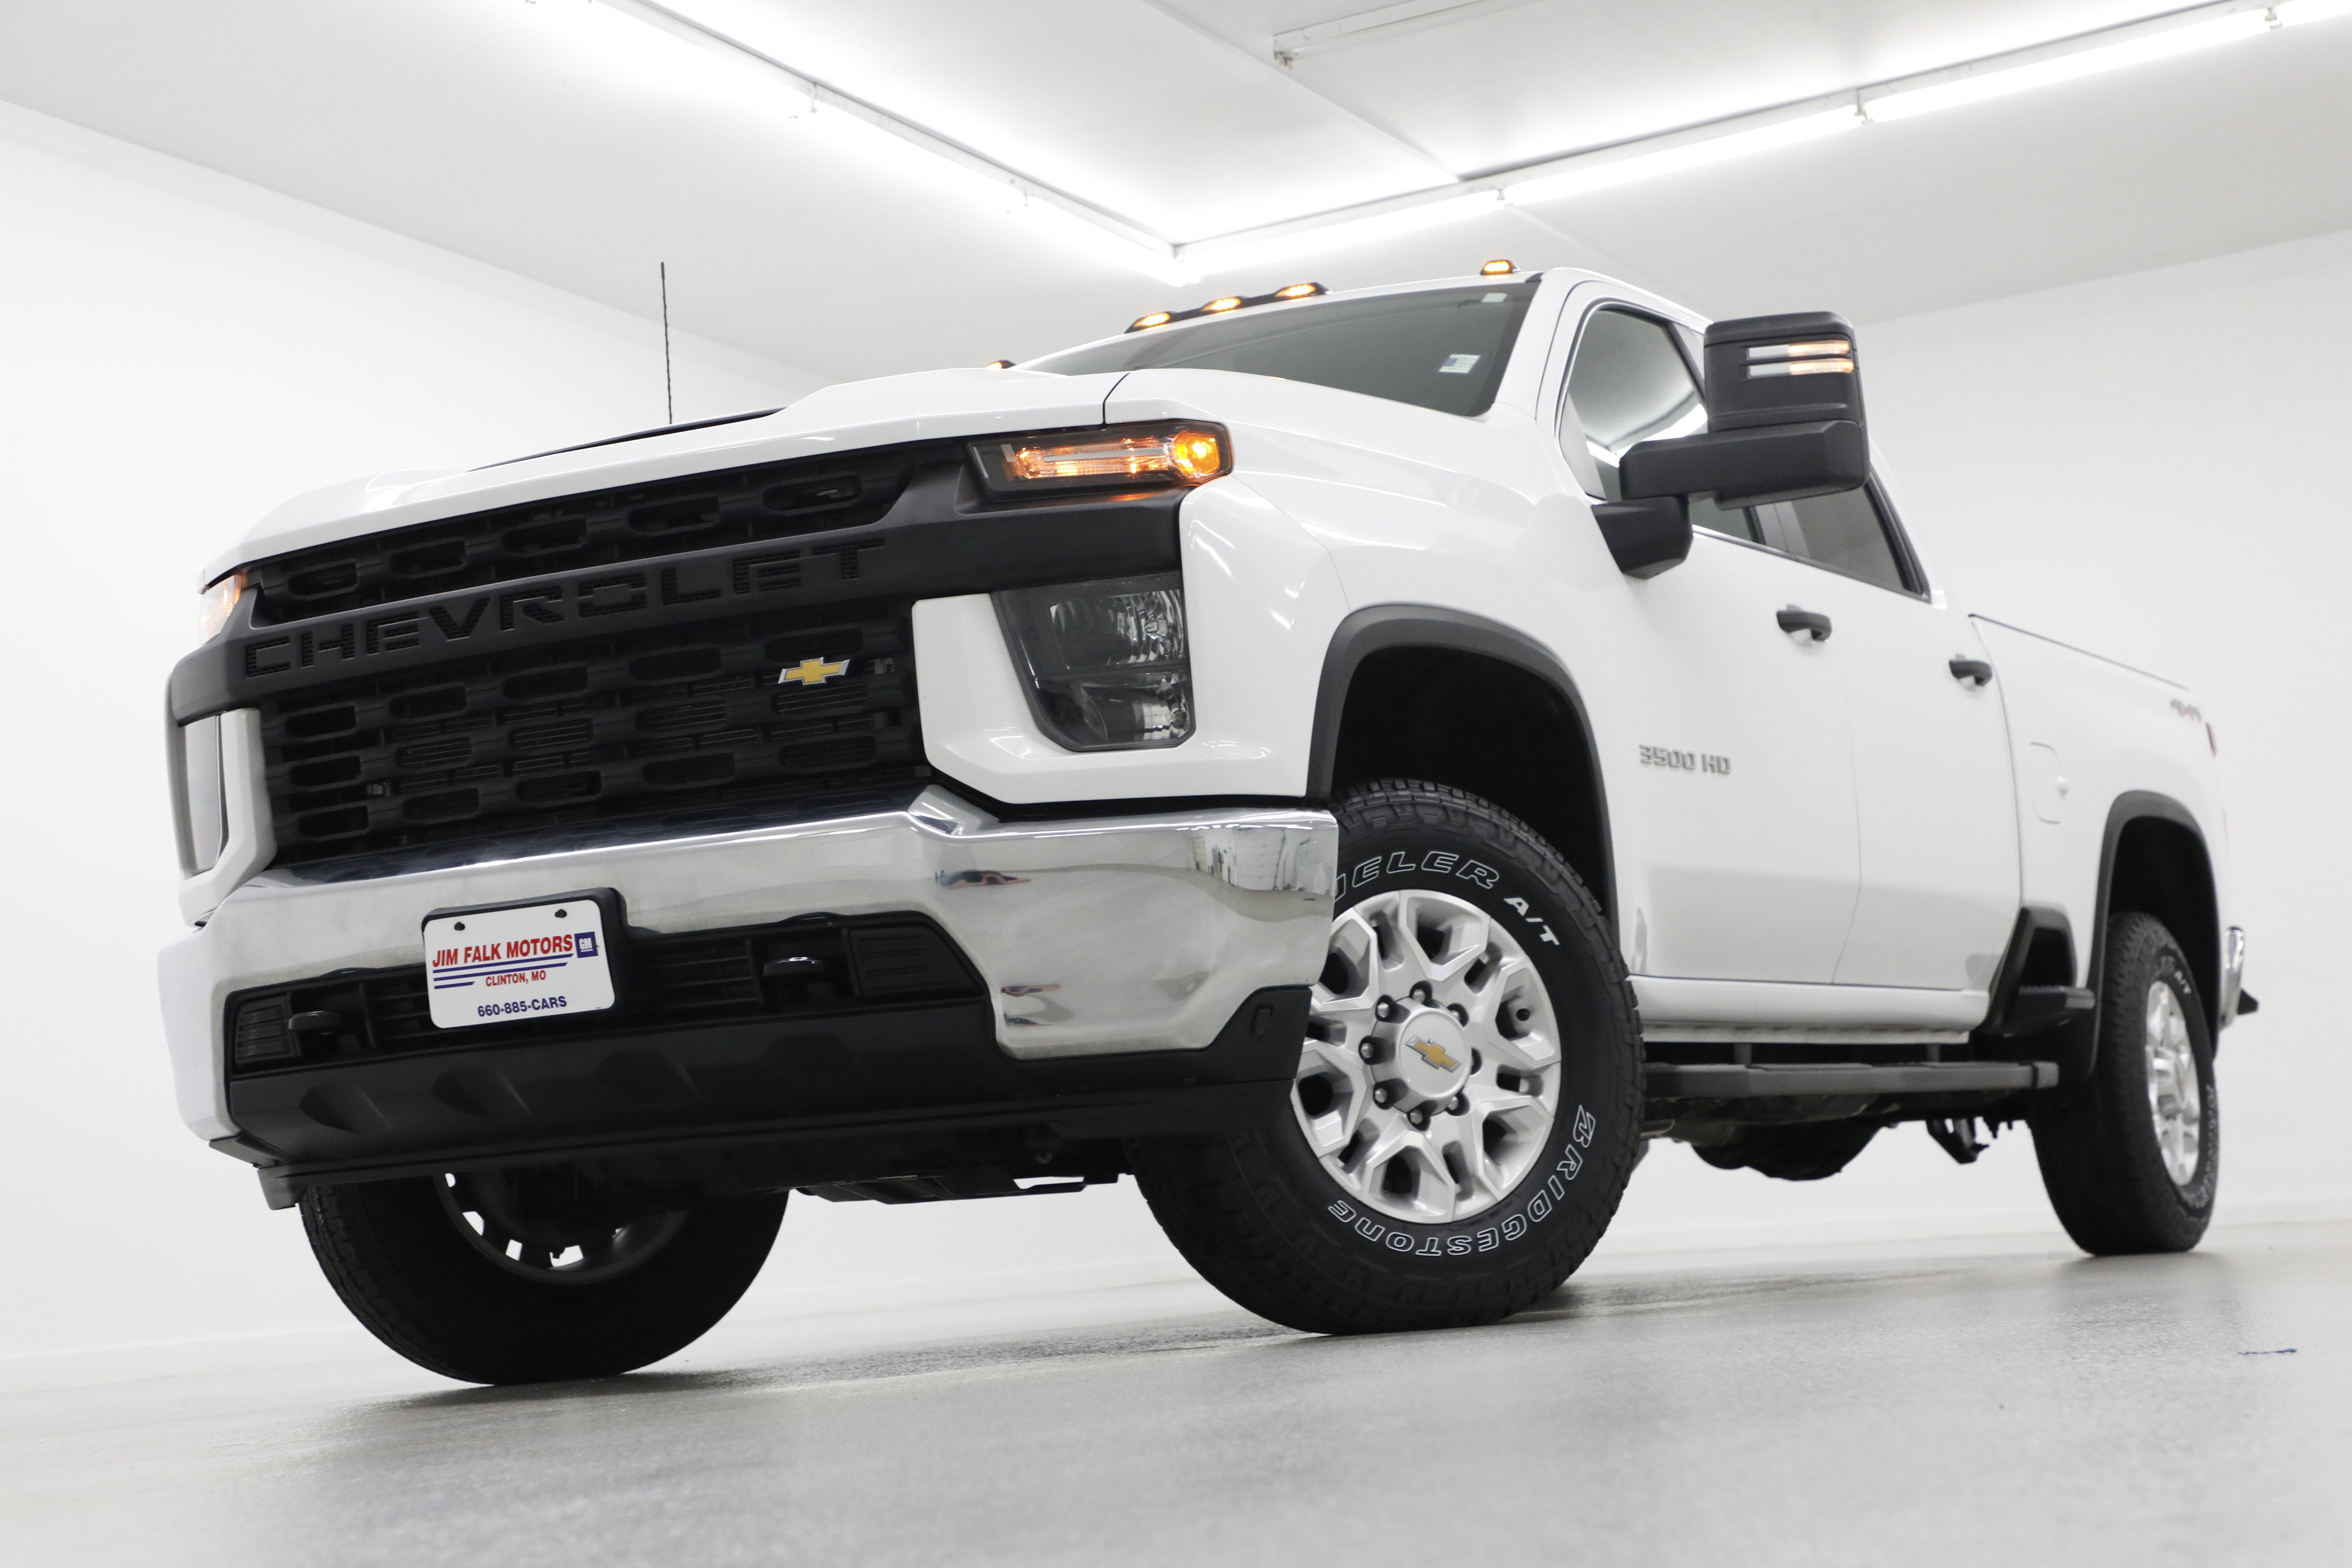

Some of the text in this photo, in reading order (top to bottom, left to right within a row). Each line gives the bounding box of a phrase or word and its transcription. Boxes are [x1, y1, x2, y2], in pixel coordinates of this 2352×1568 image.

[246, 538, 885, 679] CHEVROLET
[1639, 744, 1731, 775] 3500 HD
[1503, 897, 1560, 947] A/T
[432, 934, 572, 967] JIM FALK MOTORS
[579, 938, 593, 950] GM
[486, 970, 546, 987] CLINTON, MO
[478, 996, 567, 1017] 660-885-CARS
[1327, 1105, 1596, 1256] BRIDGESTONE
